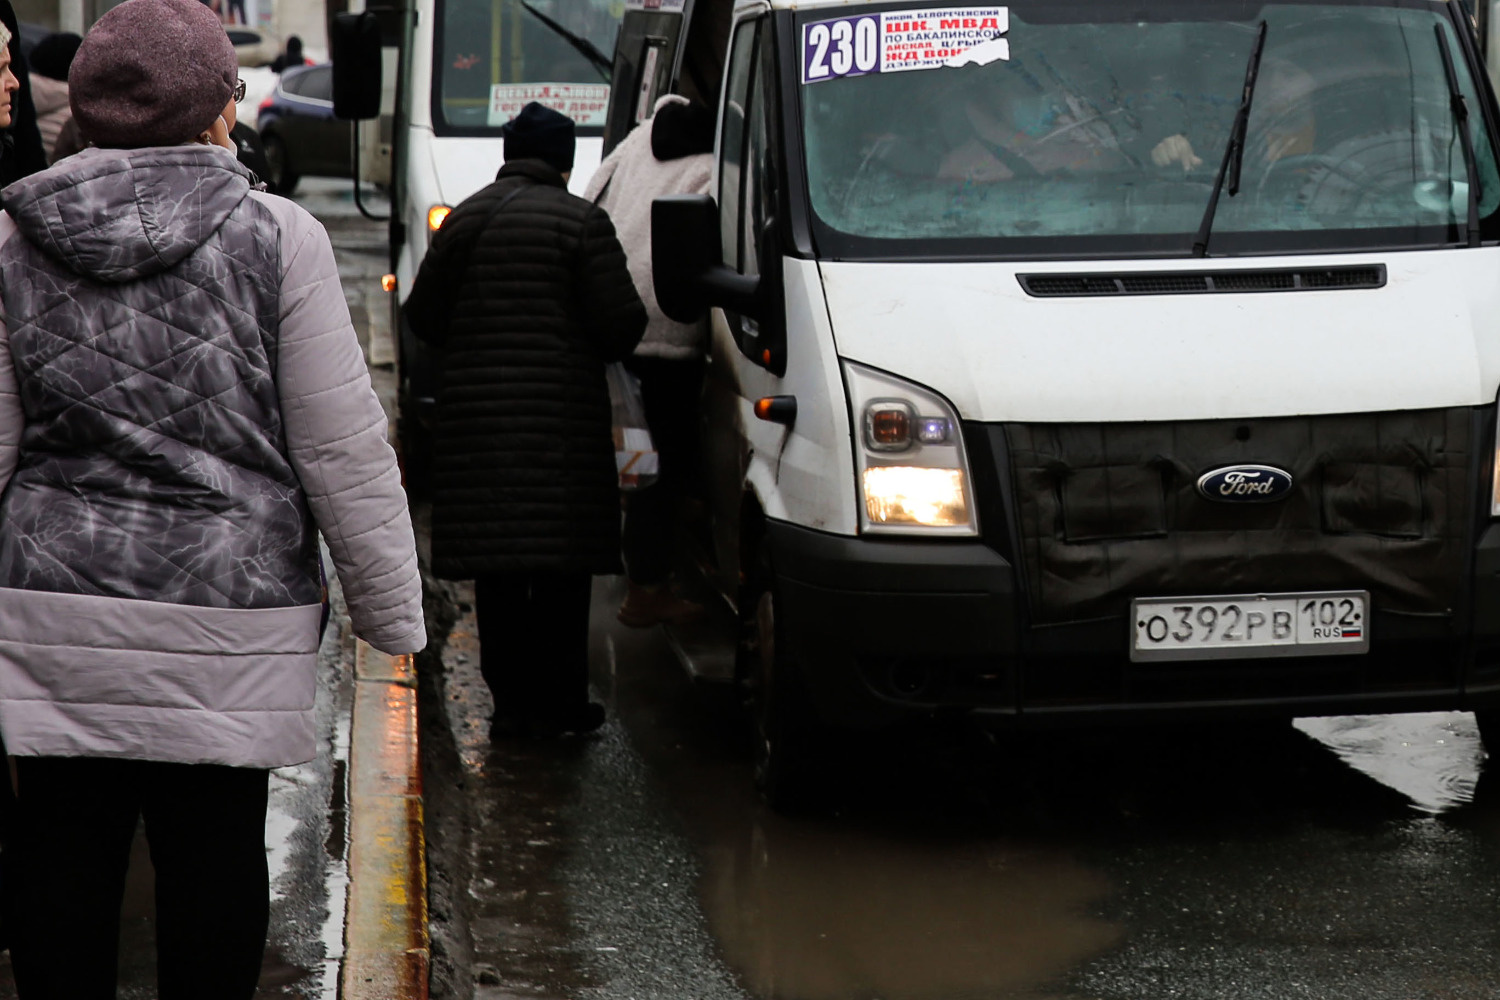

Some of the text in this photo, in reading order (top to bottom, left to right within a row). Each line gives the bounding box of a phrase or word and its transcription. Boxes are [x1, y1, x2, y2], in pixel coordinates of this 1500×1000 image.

[917, 10, 999, 19] БЕЛОРЕЧЕНСКИЙ
[886, 18, 998, 33] ШК. МВД
[885, 34, 903, 44] ПО
[808, 17, 877, 79] 230
[886, 50, 918, 62] ЖД
[568, 101, 606, 112] ДВОР
[1219, 470, 1274, 496] Ford
[1145, 598, 1356, 644] О392РВ 102
[1313, 628, 1341, 639] RUS
